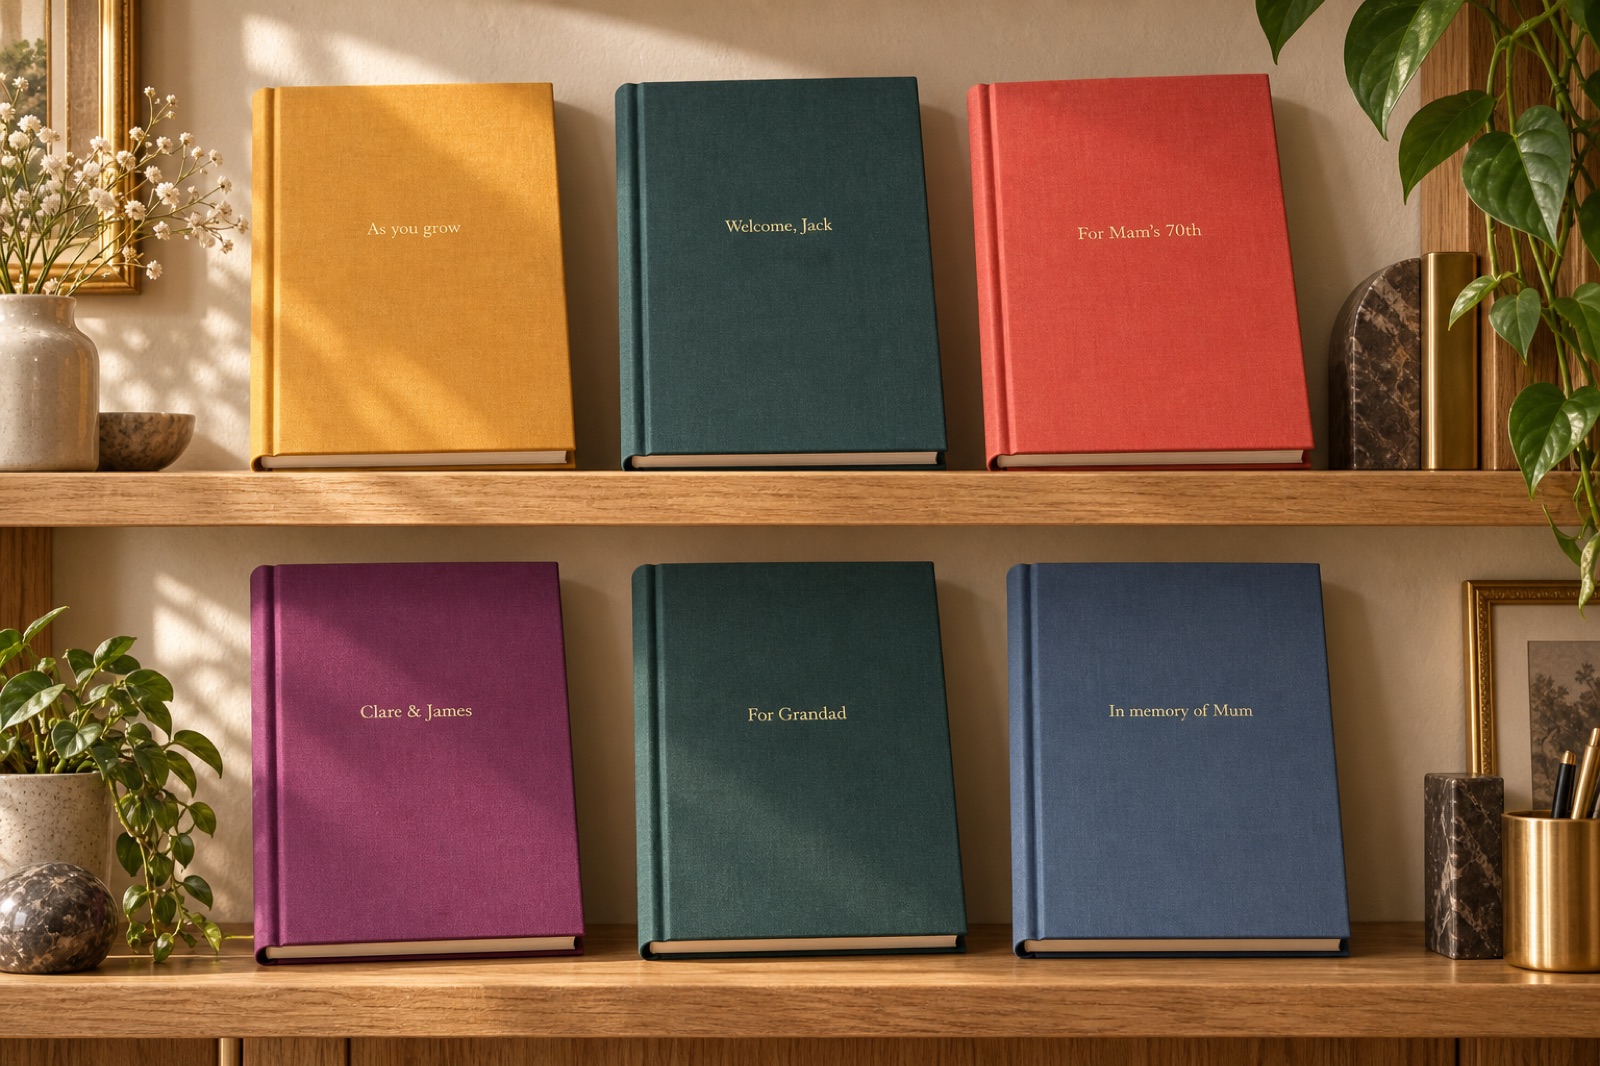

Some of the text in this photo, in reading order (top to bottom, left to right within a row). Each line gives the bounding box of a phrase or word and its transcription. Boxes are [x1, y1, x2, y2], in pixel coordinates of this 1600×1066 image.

[367, 222, 461, 239] As you grow
[725, 217, 833, 235] Welcome, Jack
[1077, 223, 1202, 240] For Mam’s 70th
[360, 703, 473, 721] Clare & James
[747, 705, 847, 722] For Grandad
[1108, 703, 1254, 721] In memory of Mum
